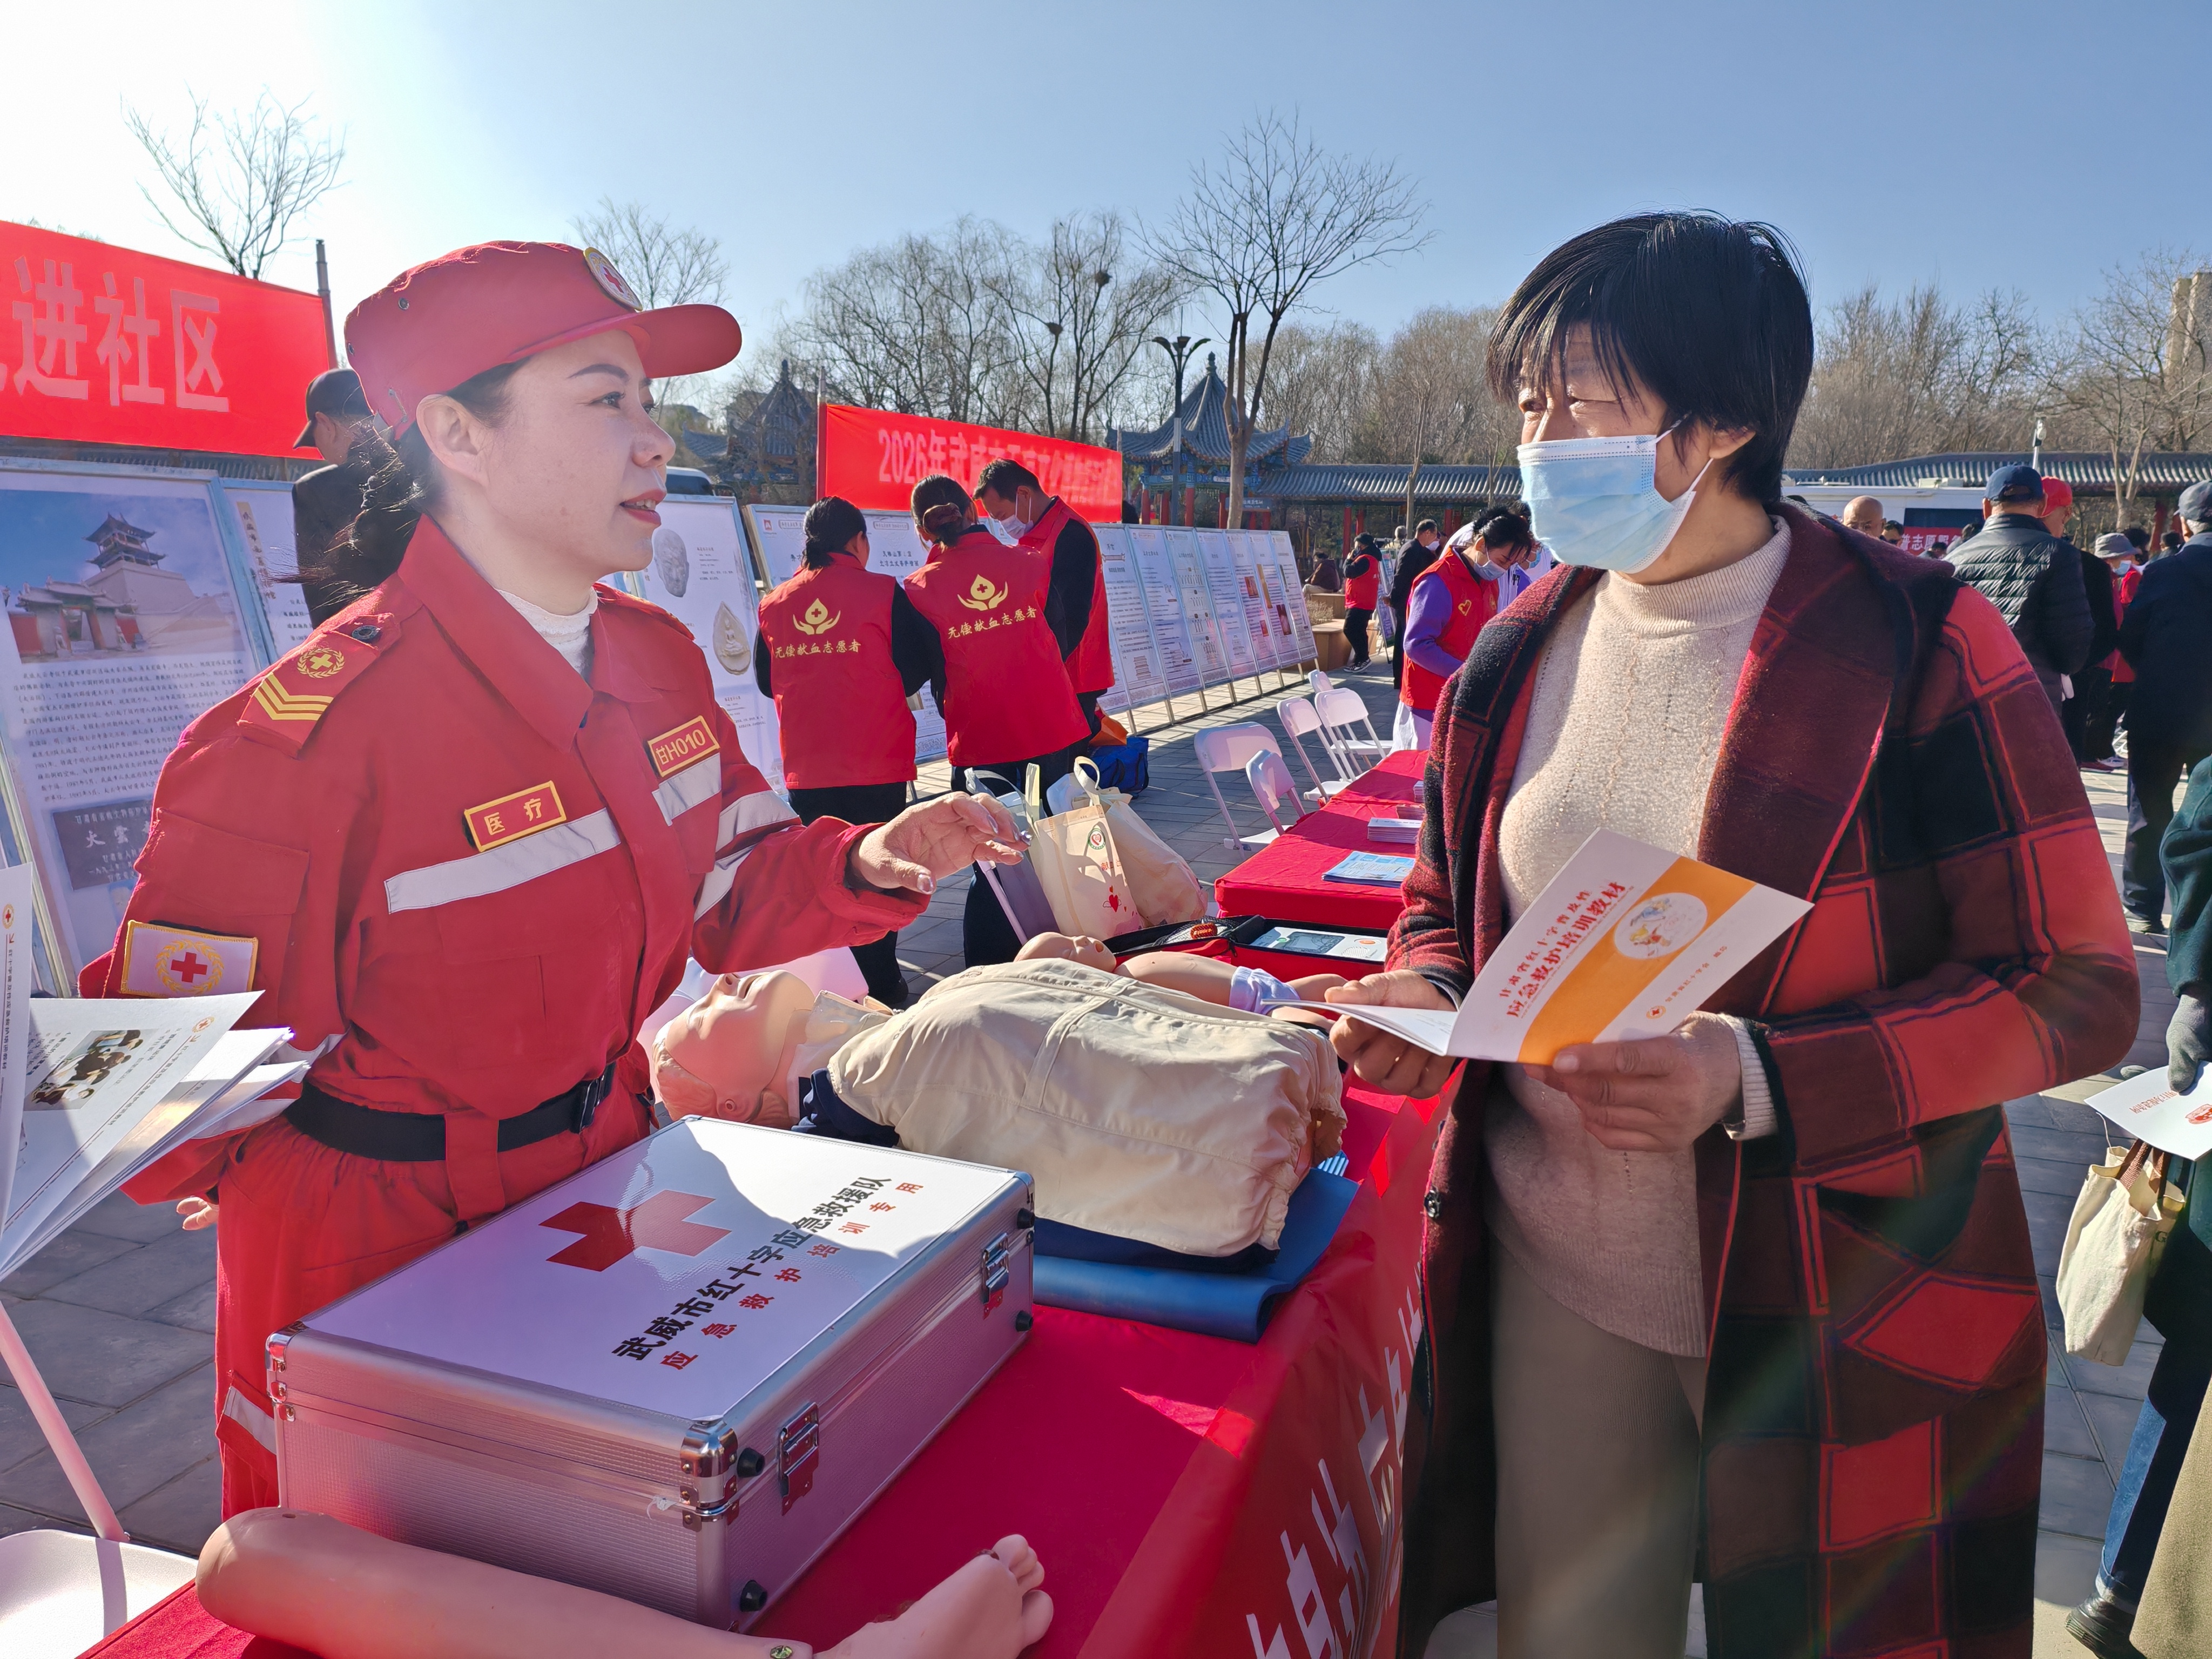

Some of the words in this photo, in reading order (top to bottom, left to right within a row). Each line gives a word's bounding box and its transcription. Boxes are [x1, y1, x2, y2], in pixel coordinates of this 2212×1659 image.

[0, 255, 230, 413] 进社区
[774, 638, 861, 658] 无偿献血志愿者
[948, 605, 1037, 639] 无偿献血志愿者
[656, 729, 707, 766] 甘H010
[484, 798, 543, 836] 医疗
[1506, 882, 1627, 1018] 应急救护培训教材
[611, 1176, 892, 1362] 武威市红十字应急救援队
[660, 1182, 923, 1371] 应急救护培训专用
